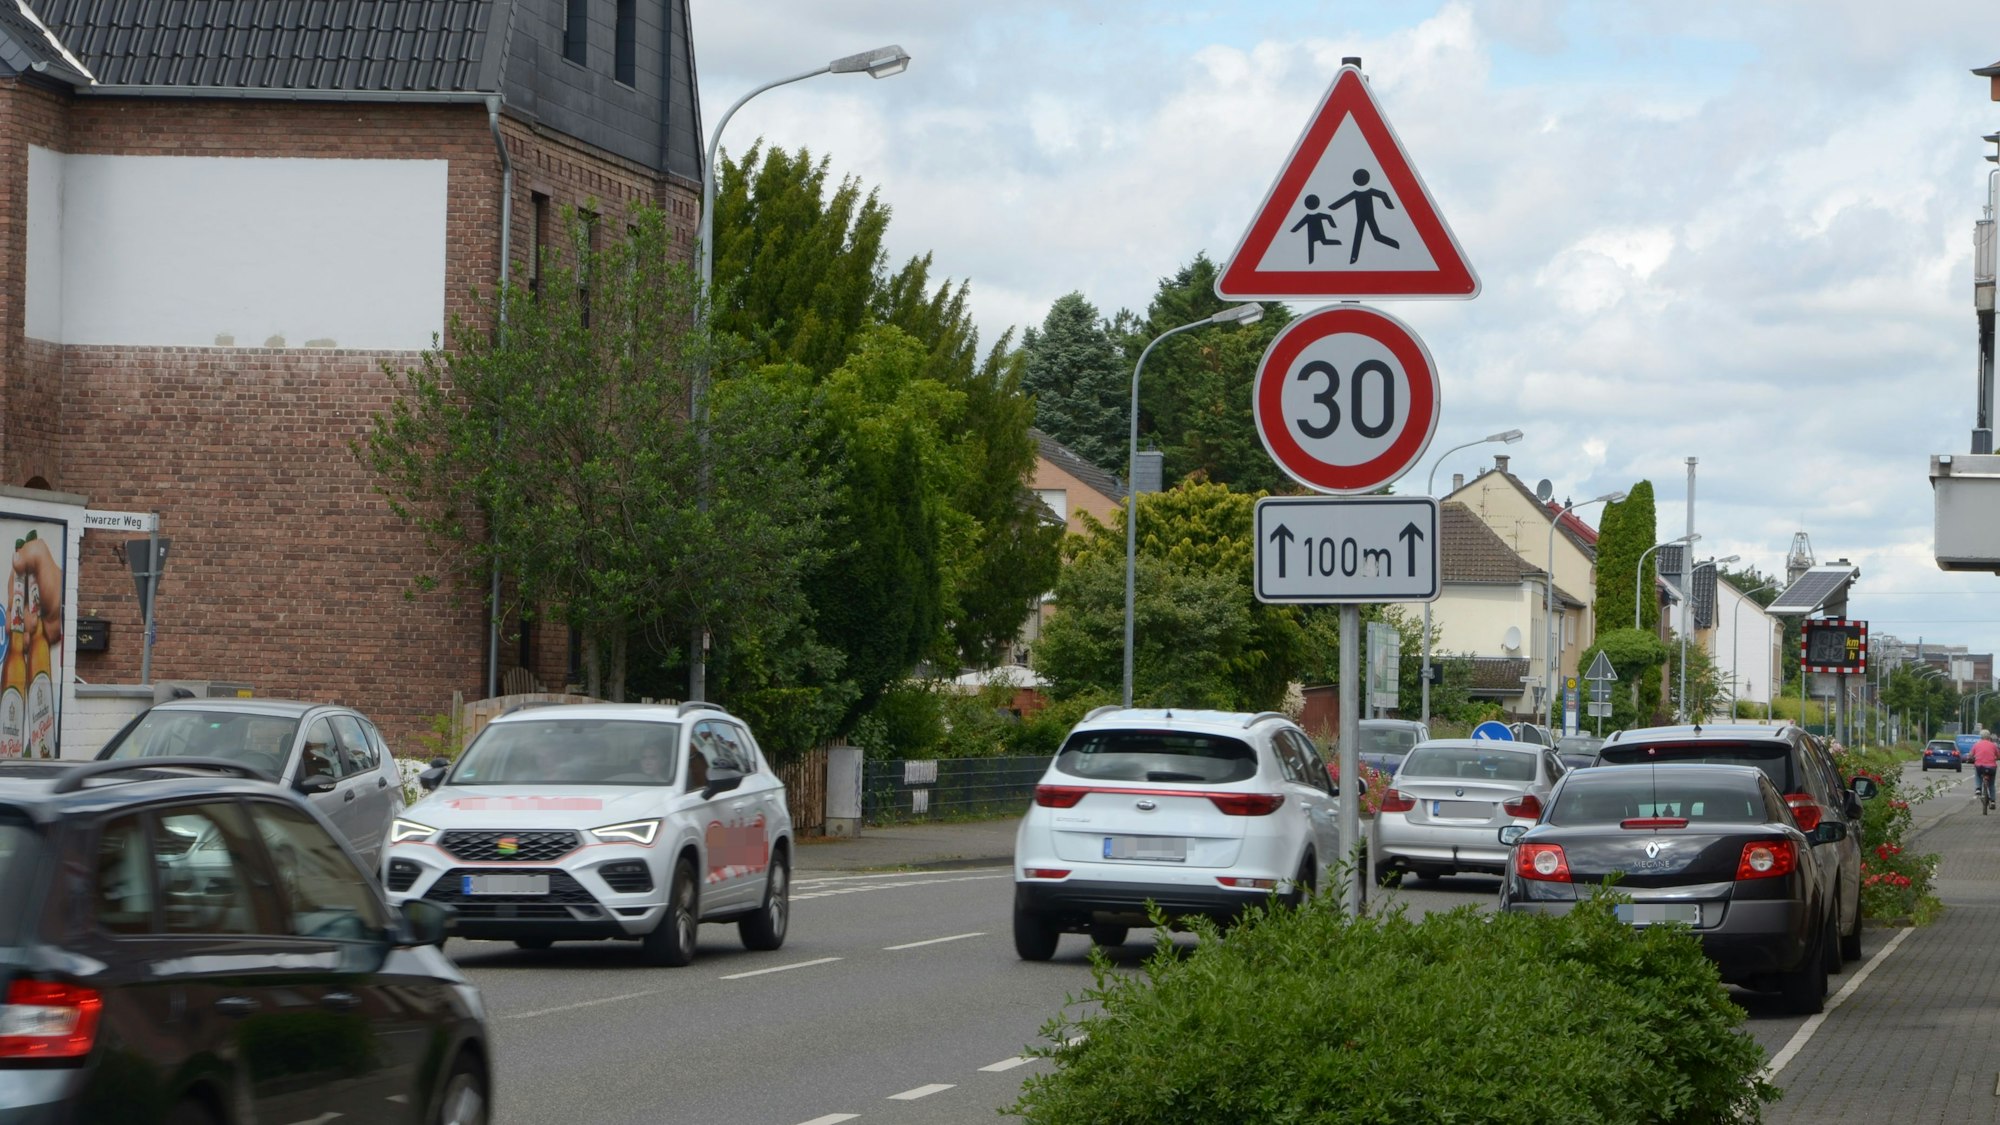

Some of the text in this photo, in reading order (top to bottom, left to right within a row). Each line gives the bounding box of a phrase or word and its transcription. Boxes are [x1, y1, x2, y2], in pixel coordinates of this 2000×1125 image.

[1297, 359, 1395, 439] 30
[84, 513, 142, 529] hwarzer Weg
[1304, 537, 1392, 577] 100m
[1846, 637, 1859, 647] km
[1849, 650, 1856, 660] h
